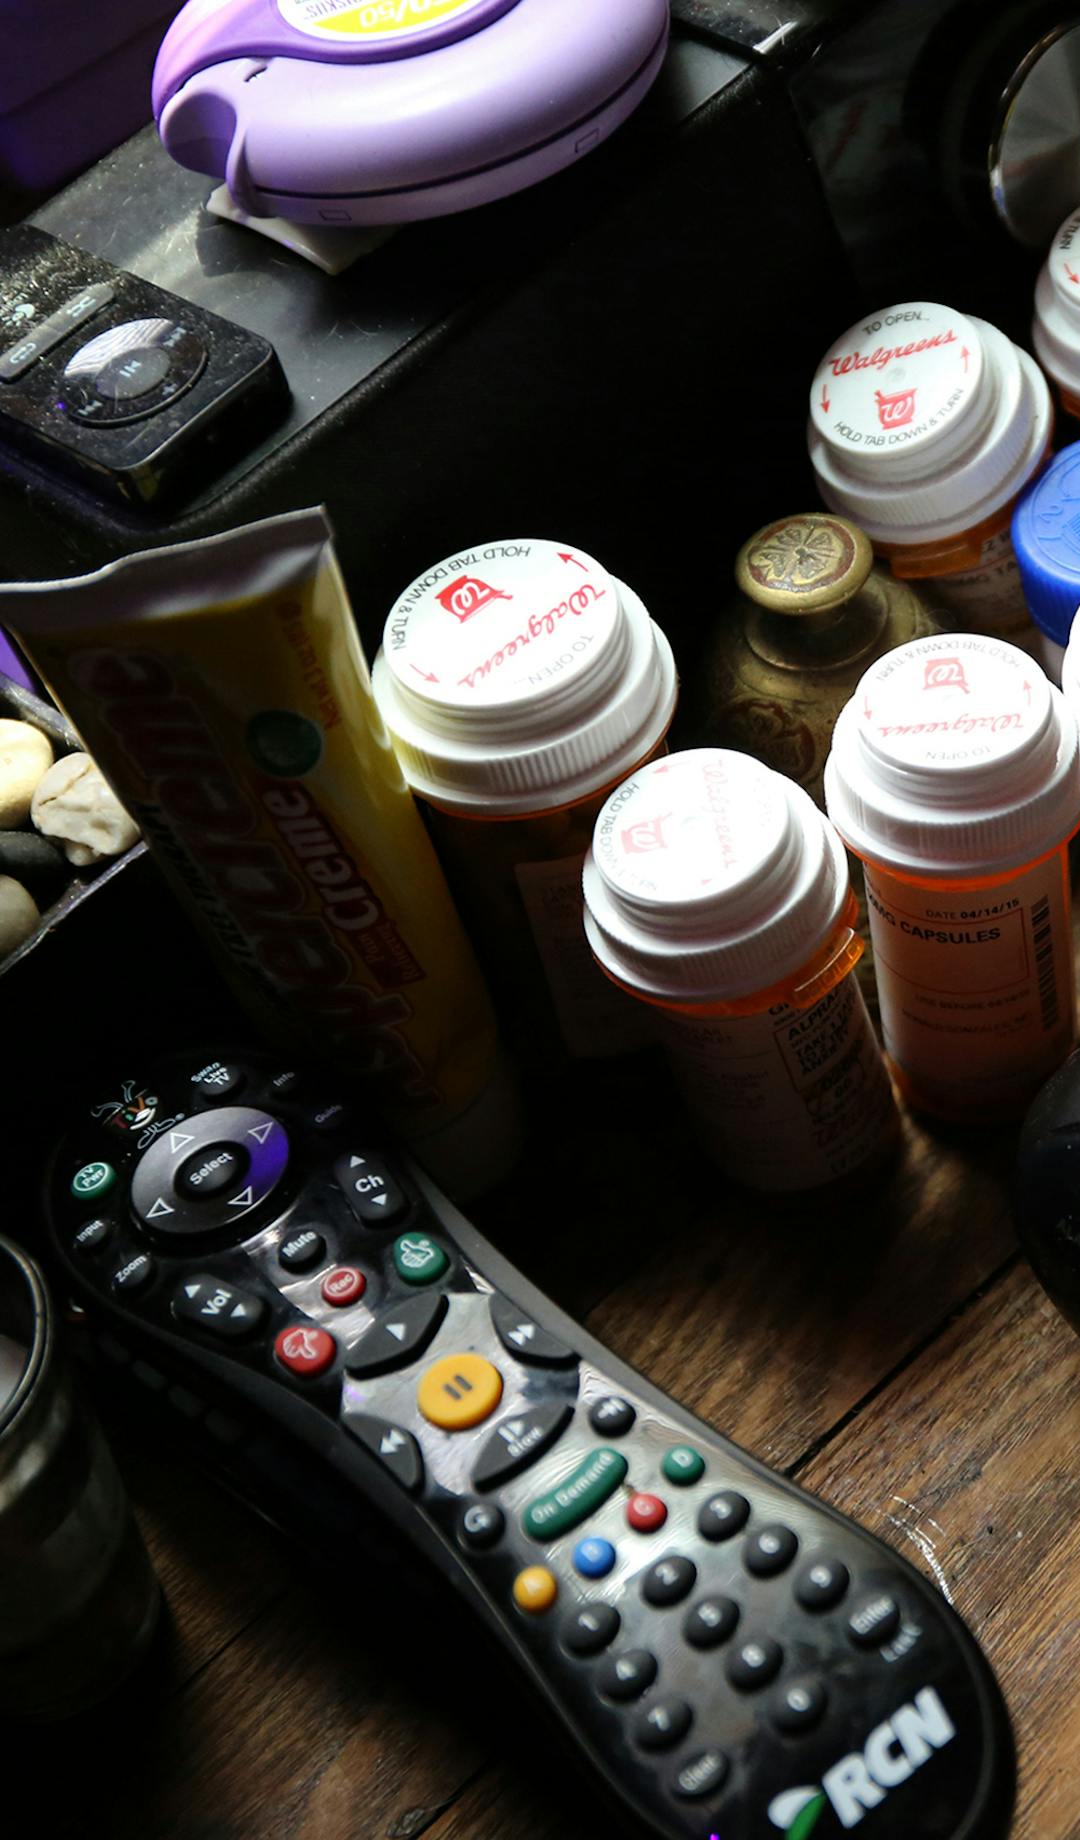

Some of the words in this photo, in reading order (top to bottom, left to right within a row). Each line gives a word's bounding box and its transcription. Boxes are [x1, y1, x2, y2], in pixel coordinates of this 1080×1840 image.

[1058, 223, 1080, 250] TURN
[861, 321, 882, 336] TO
[829, 328, 959, 377] Walgreens
[833, 420, 863, 444] HOLD
[863, 434, 886, 446] TAB
[888, 422, 929, 444] DOWN
[928, 416, 939, 427] &
[937, 387, 964, 418] TURN
[448, 553, 480, 572] TAB
[483, 545, 532, 560] HOLD
[411, 567, 449, 605] DOWN
[398, 604, 412, 615] &
[391, 615, 409, 651] TURN
[457, 583, 607, 689] Walgreens
[570, 632, 595, 652] TO
[916, 640, 960, 656] DOWN
[962, 640, 987, 655] TAB
[877, 712, 1025, 738] Walgreens
[971, 744, 992, 758] TO
[608, 781, 641, 813] HOLD
[600, 815, 617, 836] TAB
[701, 759, 740, 870] Walgreens
[261, 786, 380, 931] Creme
[924, 908, 959, 921] DATE
[959, 898, 1021, 921] 04/14/15
[900, 920, 1002, 945] CAPSULES
[213, 1072, 230, 1086] TV
[272, 1071, 296, 1087] Info
[314, 1104, 342, 1123] Guide
[79, 1166, 94, 1179] TV
[81, 1169, 104, 1188] Pwr
[187, 1151, 235, 1186] Select
[353, 1173, 385, 1194] Ch
[76, 1219, 104, 1242] Input
[281, 1229, 318, 1258] Mute
[114, 1255, 148, 1283] Zoom
[328, 1273, 354, 1295] Rec
[200, 1287, 233, 1318] Vol
[506, 1425, 544, 1458] Slow
[530, 1501, 559, 1524] On
[554, 1450, 617, 1508] Demand
[820, 1684, 957, 1830] RCN
